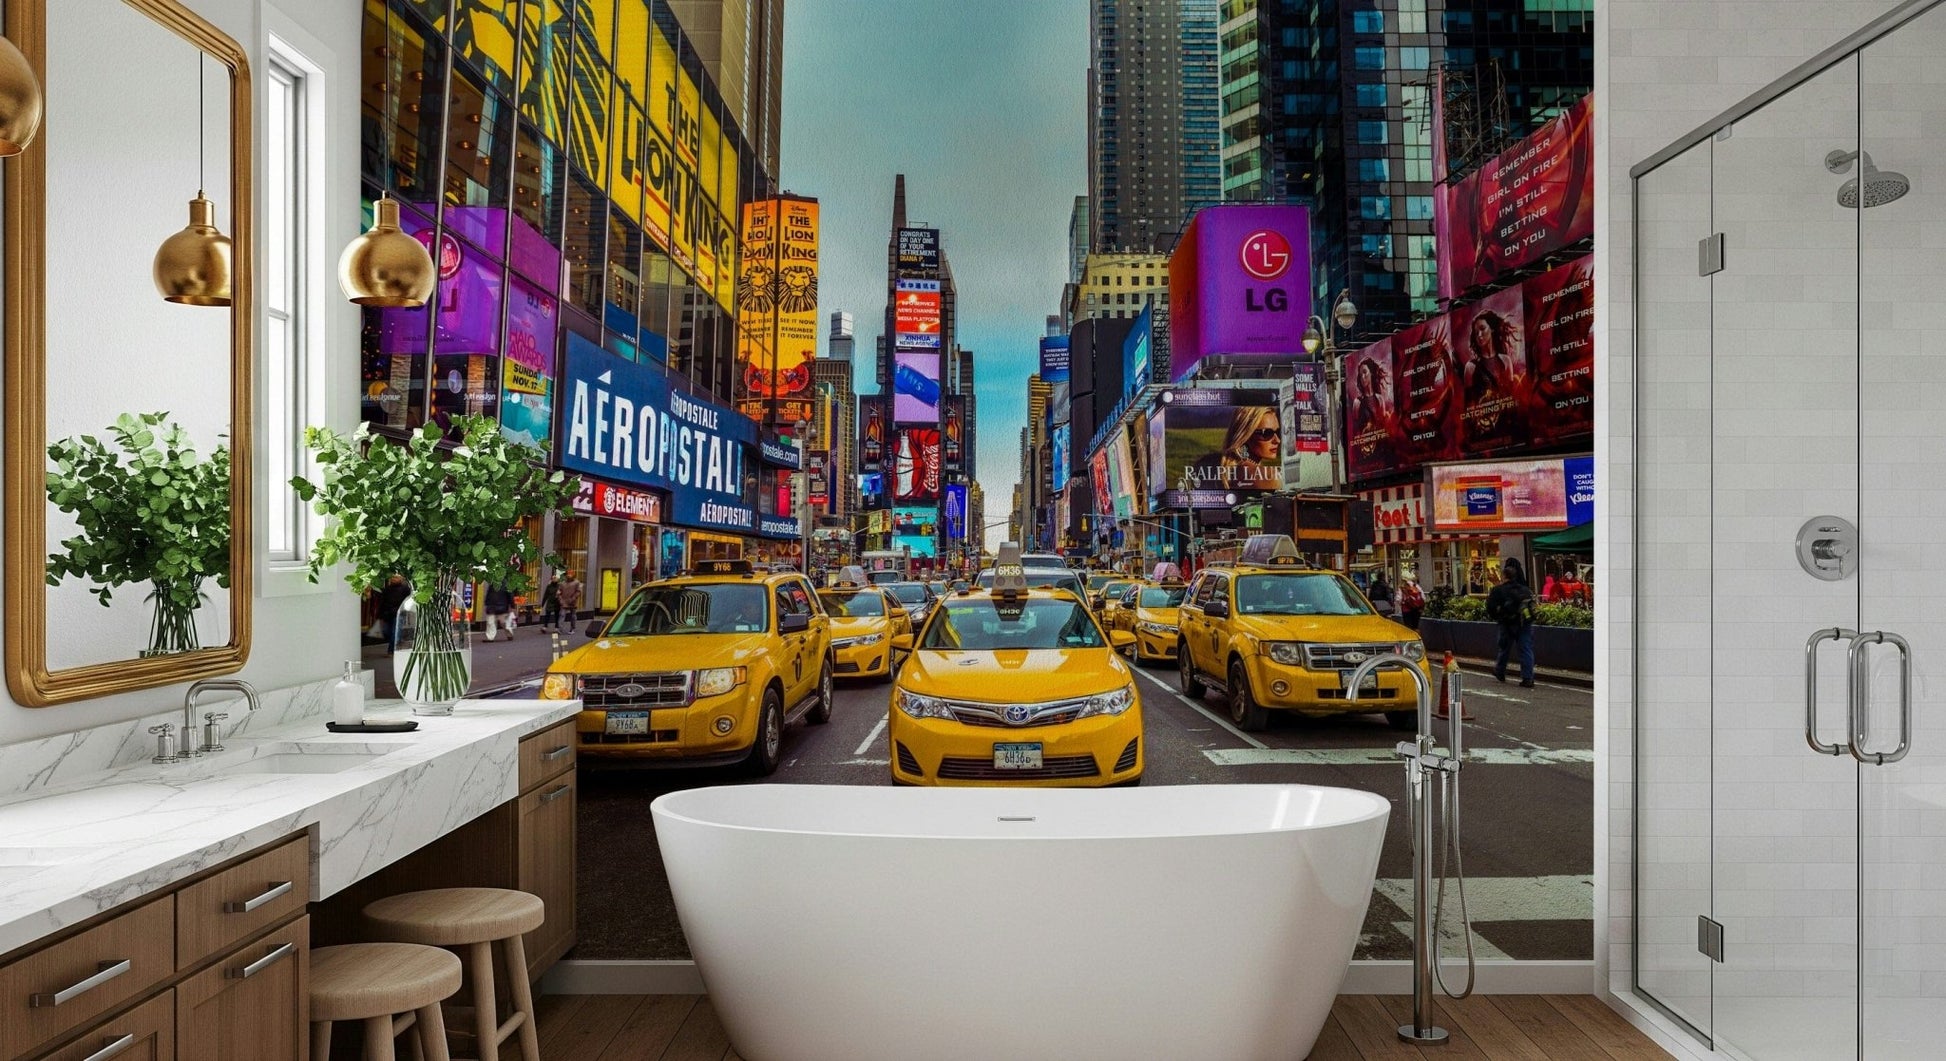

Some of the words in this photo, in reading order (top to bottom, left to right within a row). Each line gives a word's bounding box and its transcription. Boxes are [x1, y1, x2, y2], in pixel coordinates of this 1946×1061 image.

[666, 81, 698, 157] THE
[621, 78, 681, 216] LION
[1492, 138, 1550, 181] REMEMBER
[1488, 186, 1510, 204] GIRL
[1514, 173, 1529, 188] ON
[1533, 154, 1558, 177] FIRE
[1499, 204, 1513, 218] I'M
[1516, 185, 1547, 208] STILL
[684, 163, 729, 270] KING
[788, 215, 810, 225] THE
[1500, 206, 1548, 238] BETTING
[785, 226, 814, 241] LION
[1504, 242, 1519, 256] ON
[1523, 228, 1545, 246] YOU
[782, 243, 816, 259] KING
[1542, 279, 1590, 303] REMEMBER
[1246, 288, 1288, 312] LG
[1540, 319, 1559, 331] GIRL
[1561, 314, 1573, 324] ON
[1575, 306, 1594, 319] FIRE
[1405, 339, 1436, 354] REMEMBER
[1550, 346, 1560, 355] I'M
[1563, 339, 1588, 352] STILL
[1427, 360, 1440, 370] FIRE
[1295, 373, 1314, 383] SOME
[1551, 366, 1589, 382] BETTING
[1295, 383, 1316, 392] WALLS
[1419, 385, 1435, 395] STILL
[1296, 401, 1313, 410] TALK
[1555, 400, 1568, 409] ON
[1569, 395, 1589, 405] YOU
[1411, 408, 1436, 419] BETTING
[1460, 405, 1500, 420] CATCHING
[1422, 431, 1435, 439] YOU
[1185, 466, 1237, 480] RALPH
[1244, 466, 1281, 480] LAUR
[616, 492, 654, 516] ELEMENT
[700, 498, 752, 527] AÉROPOSTALE
[1375, 503, 1410, 529] Foot
[998, 566, 1021, 576] 6H36
